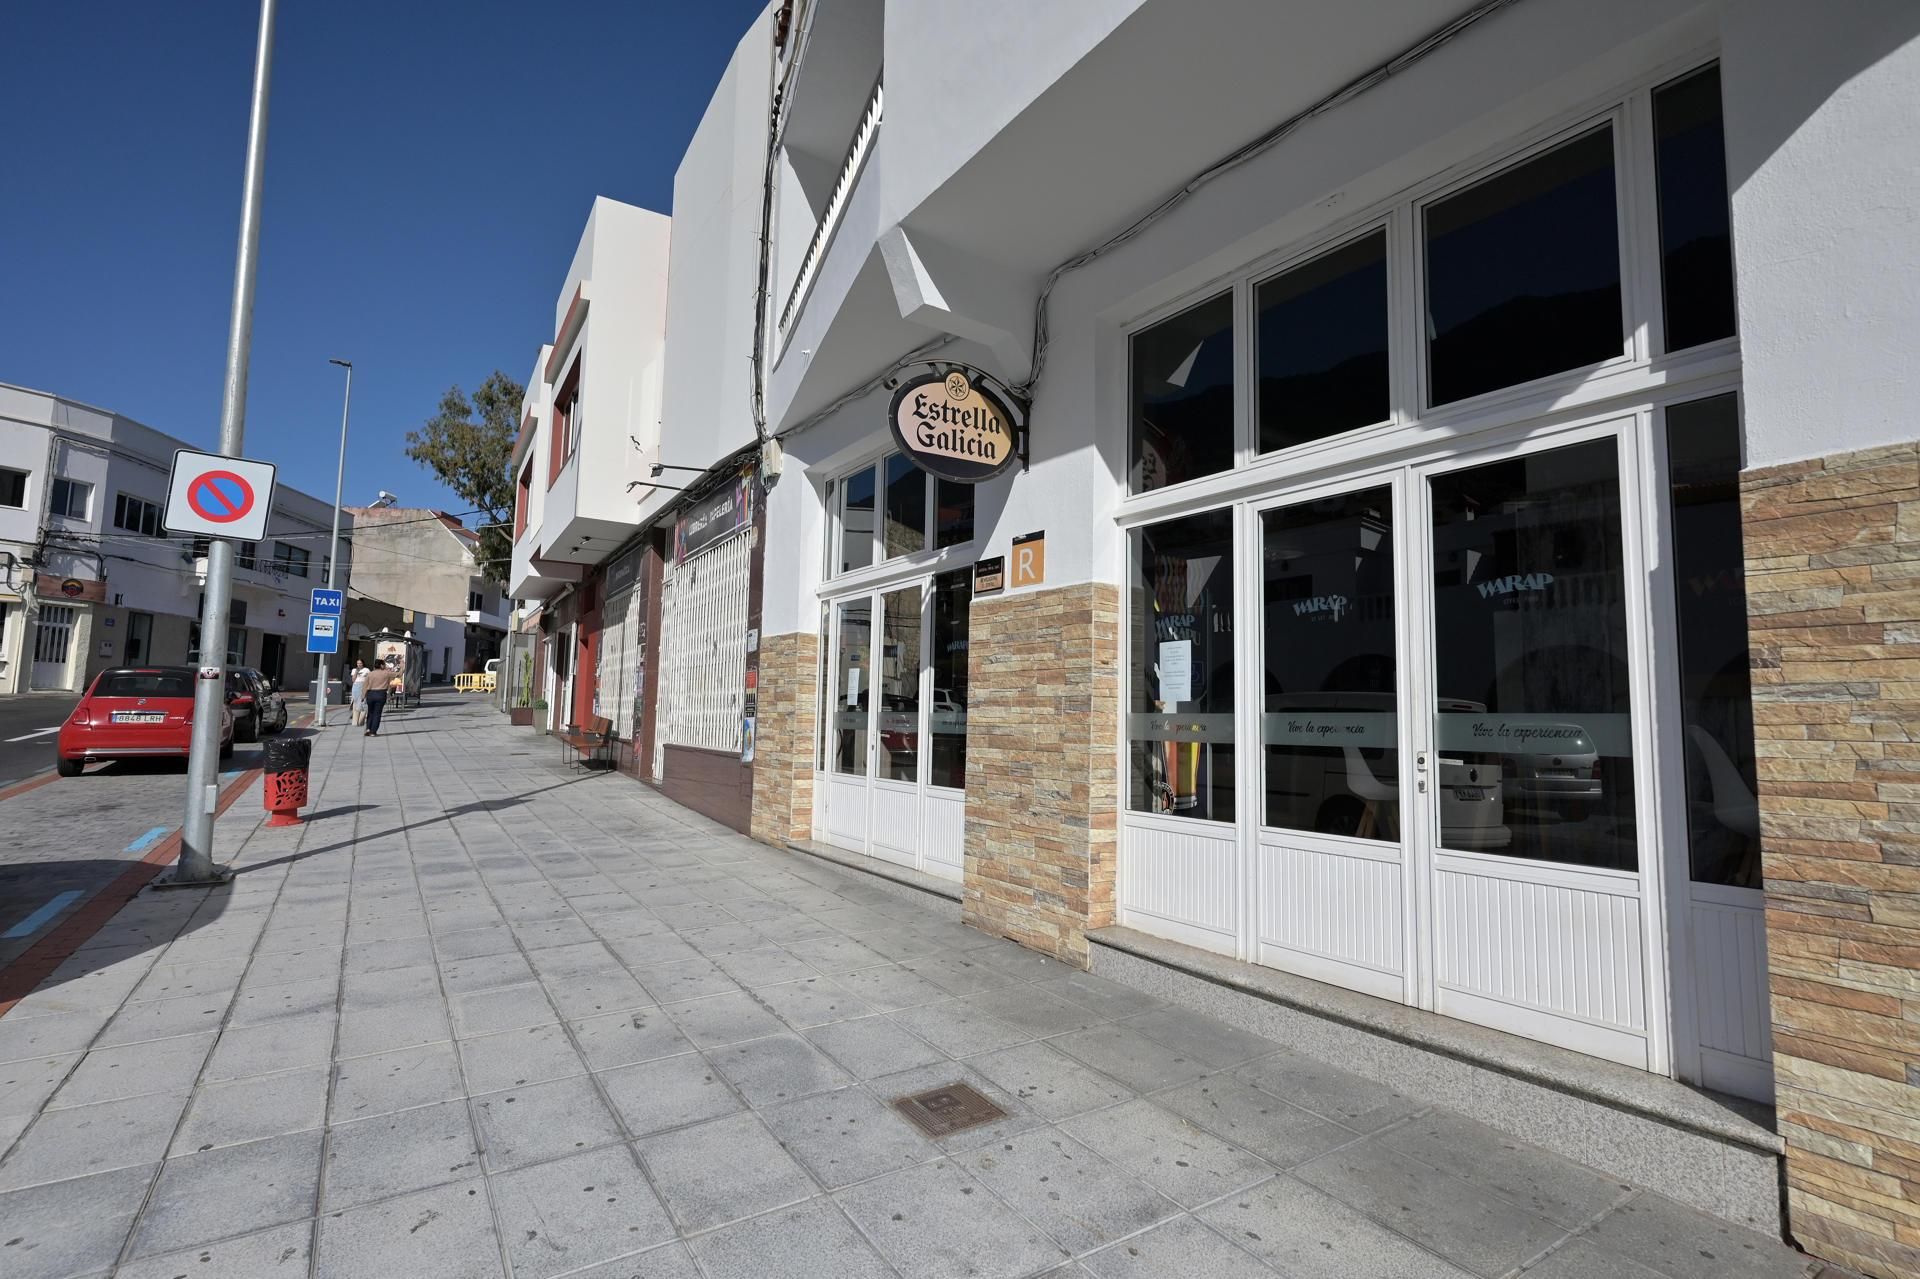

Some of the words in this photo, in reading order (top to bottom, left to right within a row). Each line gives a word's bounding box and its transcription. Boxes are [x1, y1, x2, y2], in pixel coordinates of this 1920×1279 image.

[911, 392, 1001, 435] Estrella
[916, 421, 996, 460] Galicia
[1019, 547, 1036, 581] R
[1477, 572, 1554, 599] WARAP
[314, 597, 340, 607] TAXI
[1293, 595, 1348, 617] WARAP
[1288, 720, 1302, 733] Vive
[1306, 720, 1314, 733] la
[1472, 723, 1494, 737] Vive
[1498, 723, 1511, 737] la
[1513, 727, 1584, 743] experiencia
